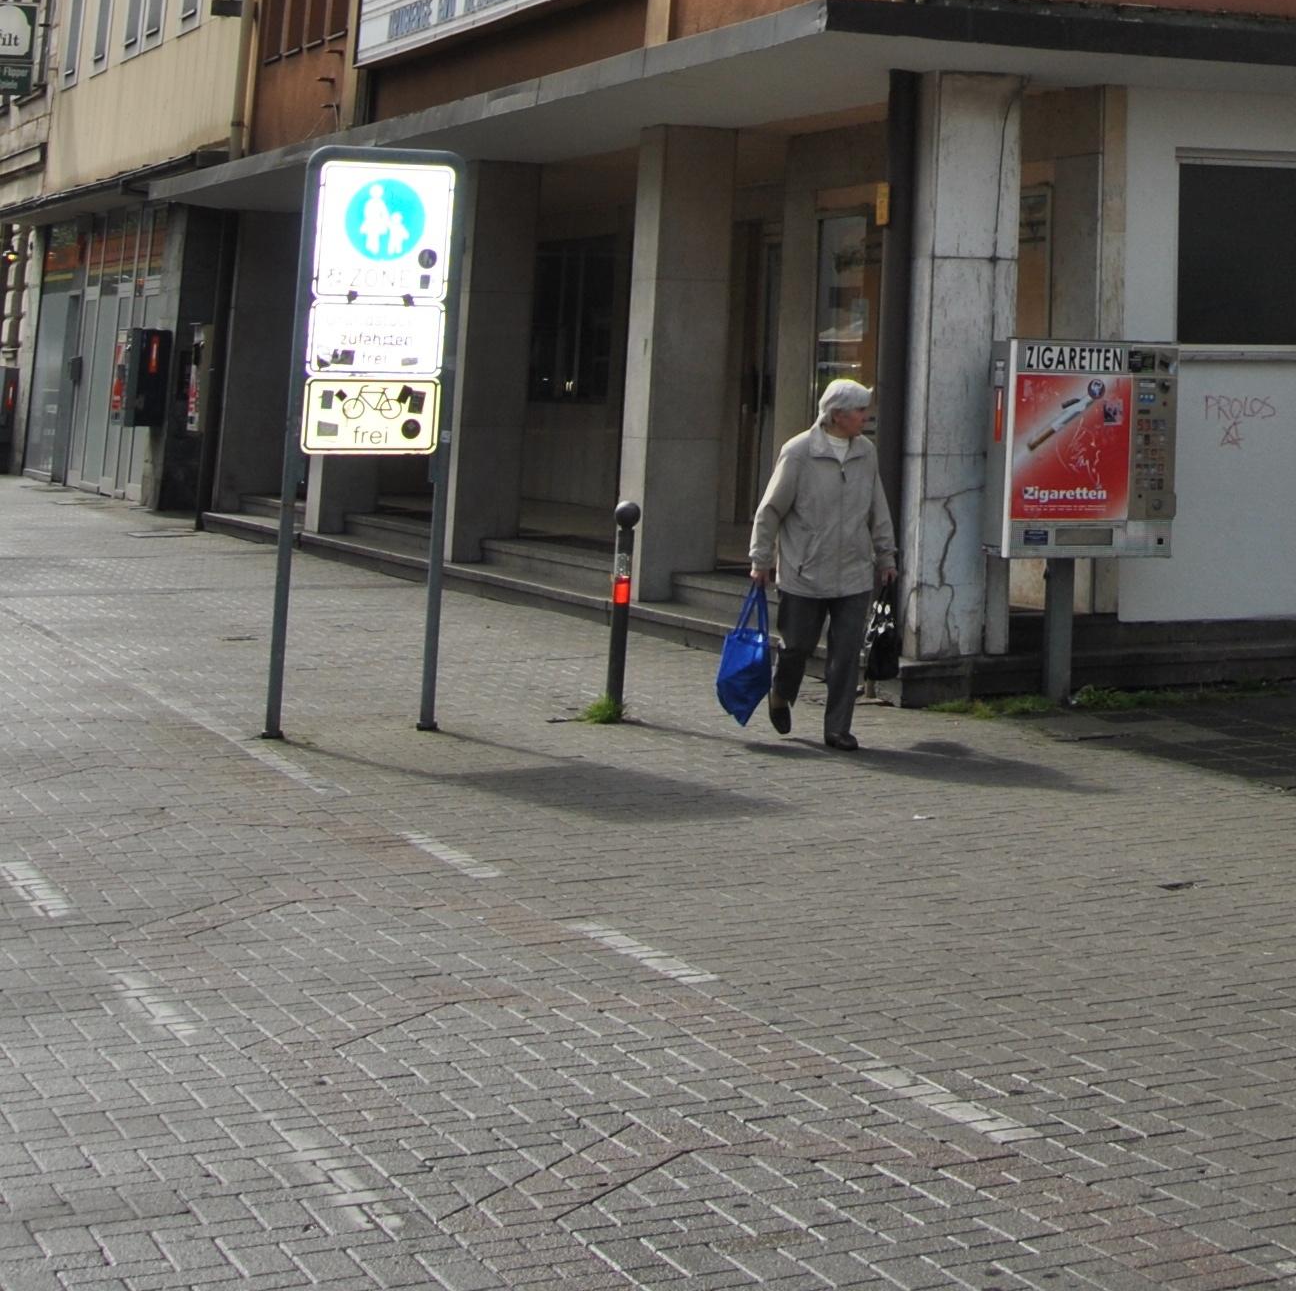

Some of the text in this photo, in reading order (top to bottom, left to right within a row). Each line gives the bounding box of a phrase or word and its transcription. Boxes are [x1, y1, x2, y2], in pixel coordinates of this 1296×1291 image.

[350, 269, 411, 287] ZONE
[1026, 345, 1123, 371] ZIGARETTEN
[354, 426, 389, 444] frei
[1023, 486, 1107, 502] Zigaretten
